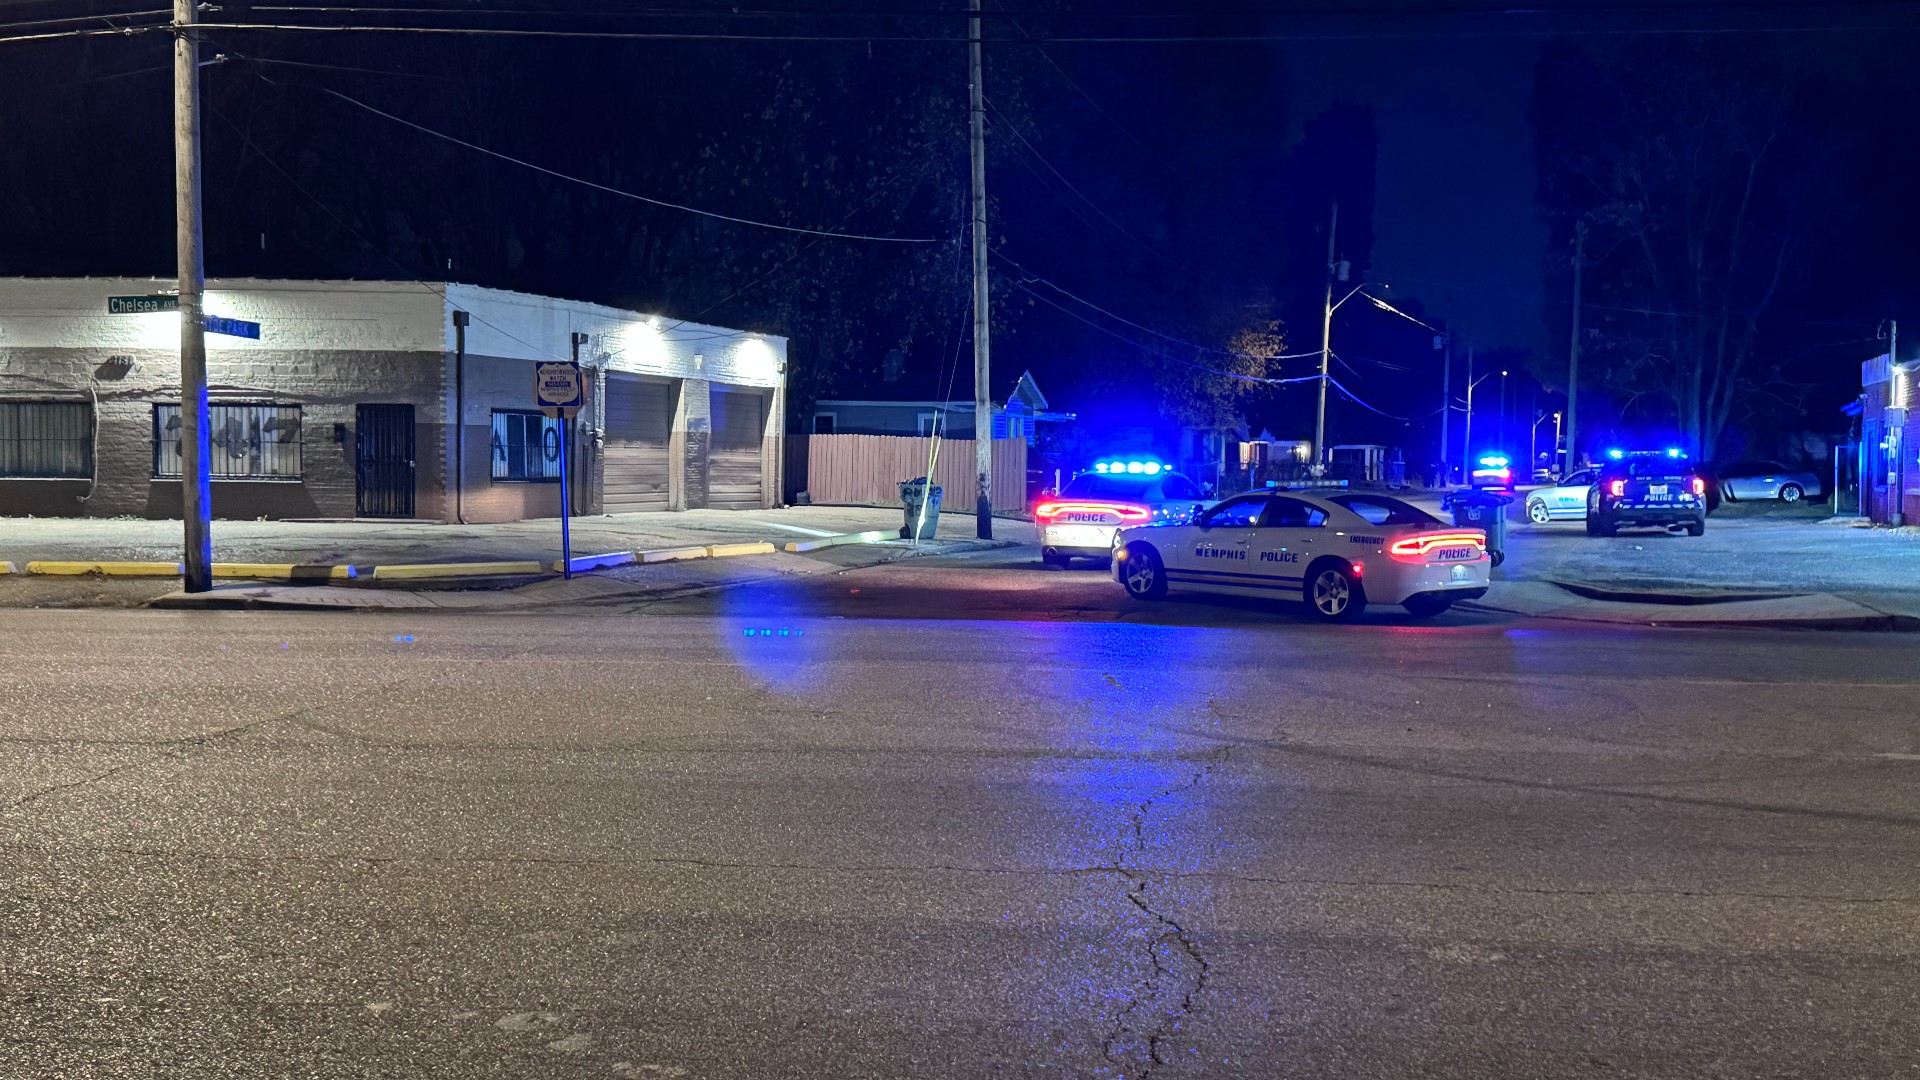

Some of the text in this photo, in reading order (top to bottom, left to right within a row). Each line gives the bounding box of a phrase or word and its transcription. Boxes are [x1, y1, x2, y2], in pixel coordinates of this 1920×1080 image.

[111, 298, 177, 312] Chelsea AVE
[204, 316, 225, 334] YDE
[226, 319, 249, 337] PARK
[1067, 513, 1106, 522] POLICE
[1349, 535, 1385, 545] EMERGENCY
[1195, 547, 1299, 563] MEMPHIS POLICE
[1438, 548, 1471, 560] POLICE
